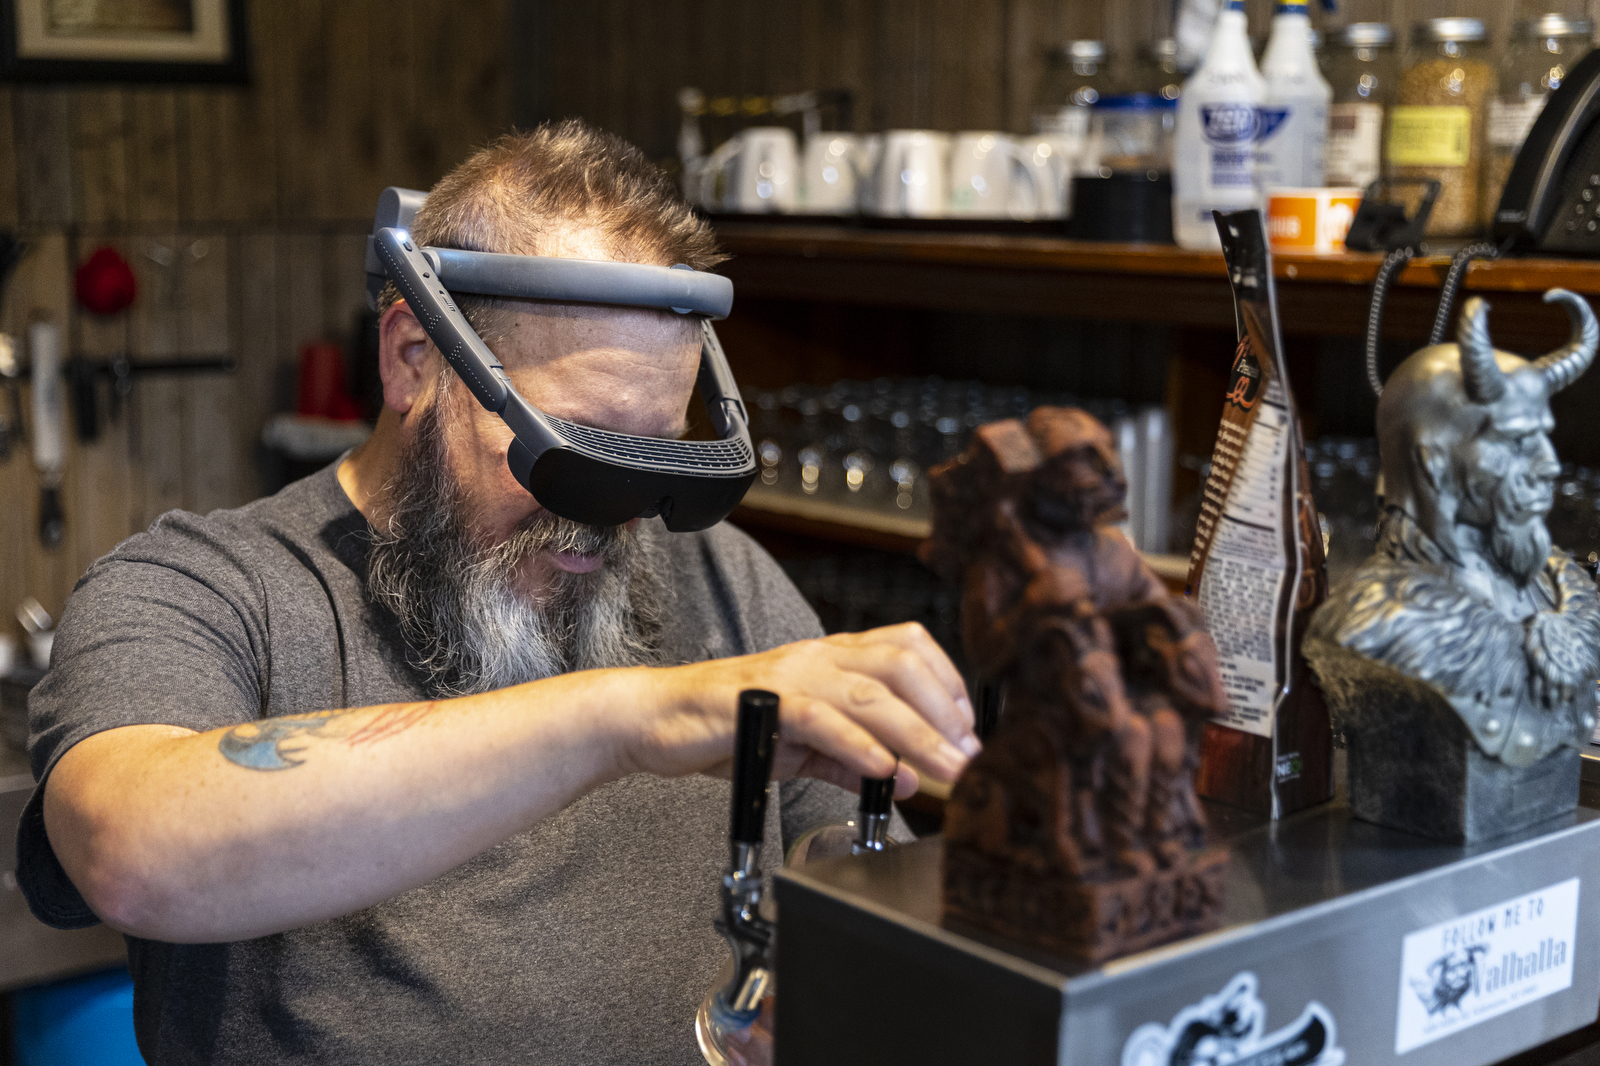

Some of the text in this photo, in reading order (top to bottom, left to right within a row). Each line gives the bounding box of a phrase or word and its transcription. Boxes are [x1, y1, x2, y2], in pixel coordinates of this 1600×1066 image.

[1442, 897, 1544, 945] FOLLOW ME TO
[1470, 937, 1567, 997] Valhalla
